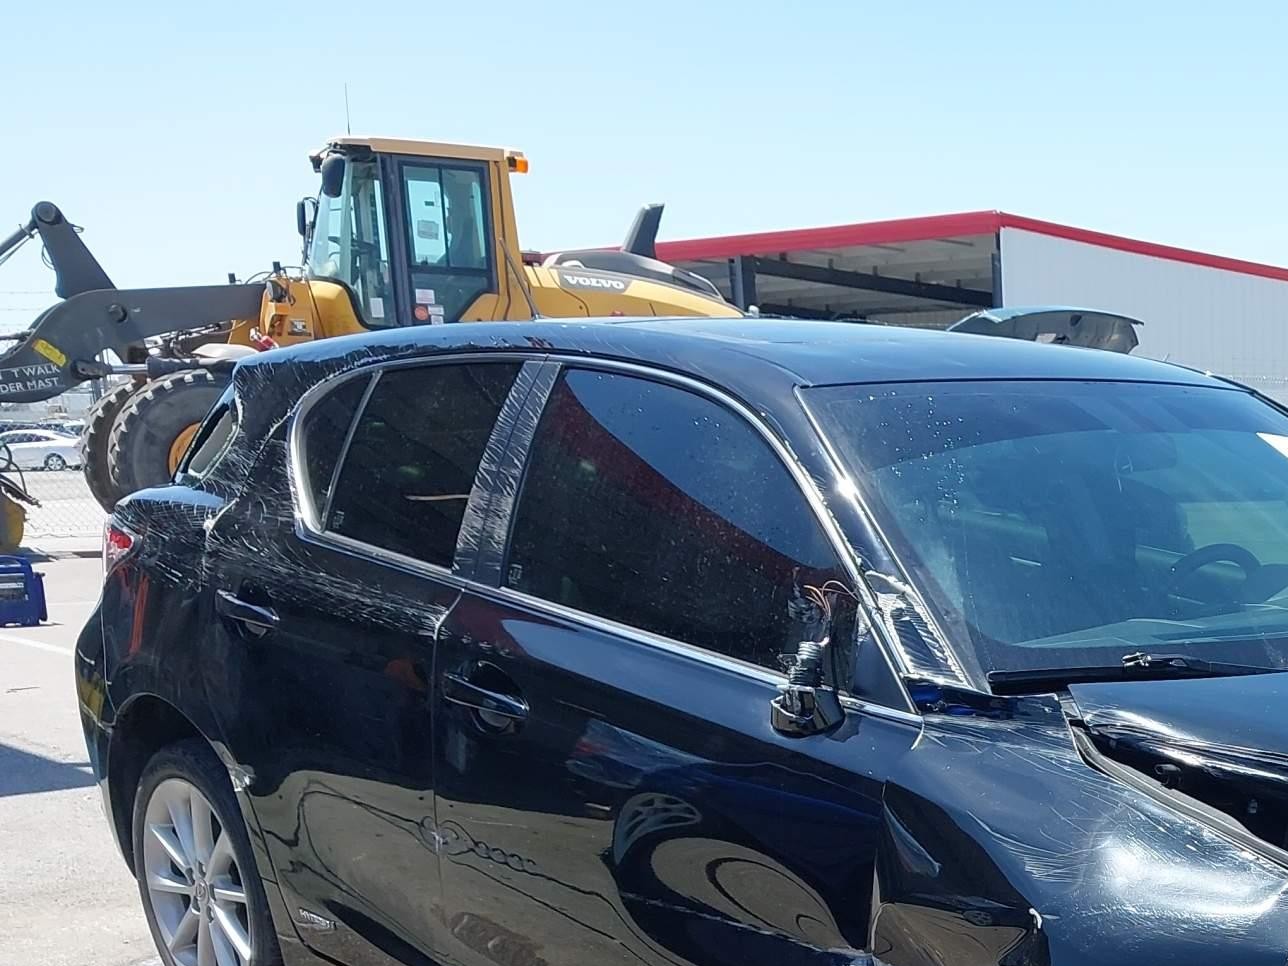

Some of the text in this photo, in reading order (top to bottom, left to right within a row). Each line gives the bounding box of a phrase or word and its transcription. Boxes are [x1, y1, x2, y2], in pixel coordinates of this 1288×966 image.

[563, 275, 625, 290] VOLVO
[22, 364, 61, 377] WALK
[26, 377, 59, 391] MAST
